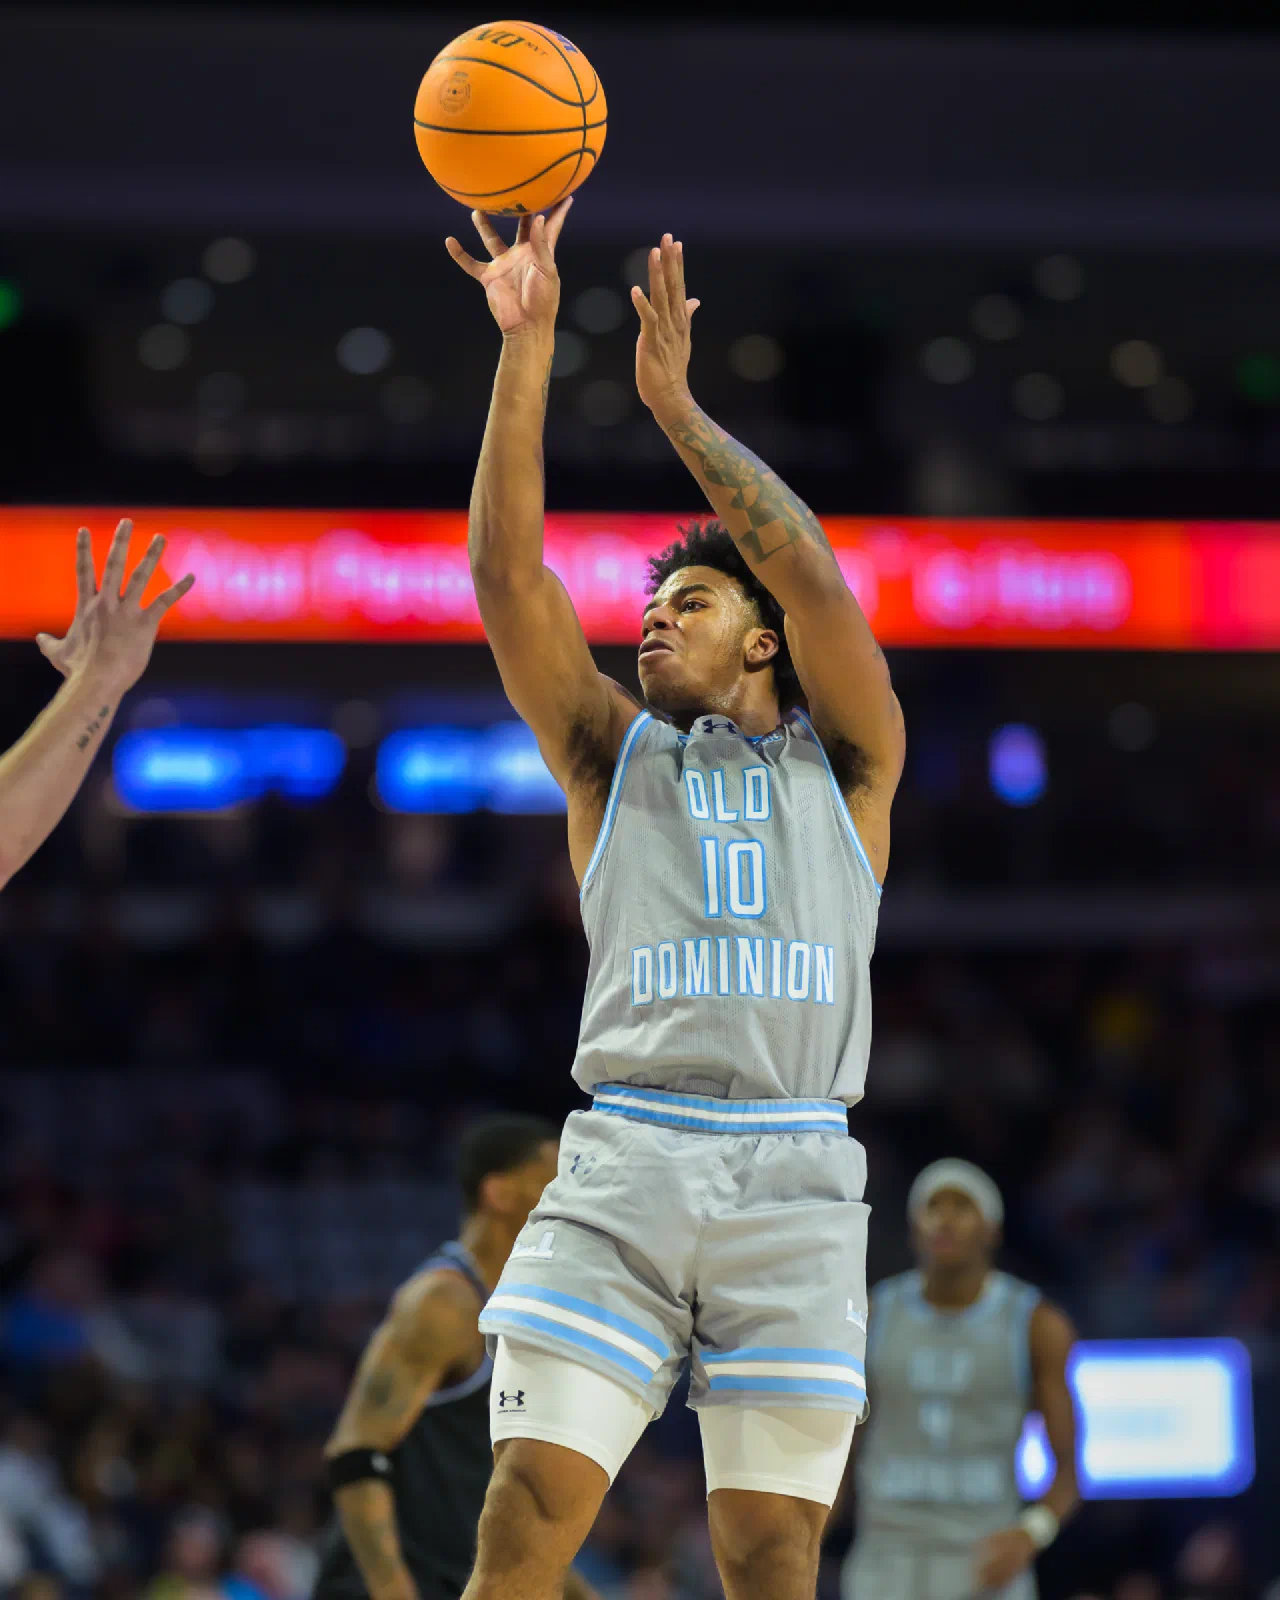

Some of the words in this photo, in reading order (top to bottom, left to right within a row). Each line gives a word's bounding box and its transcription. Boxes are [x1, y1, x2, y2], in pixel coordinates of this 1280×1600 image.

[684, 766, 771, 823] OLD
[700, 836, 767, 919] 10
[631, 936, 835, 1006] DOMINION
